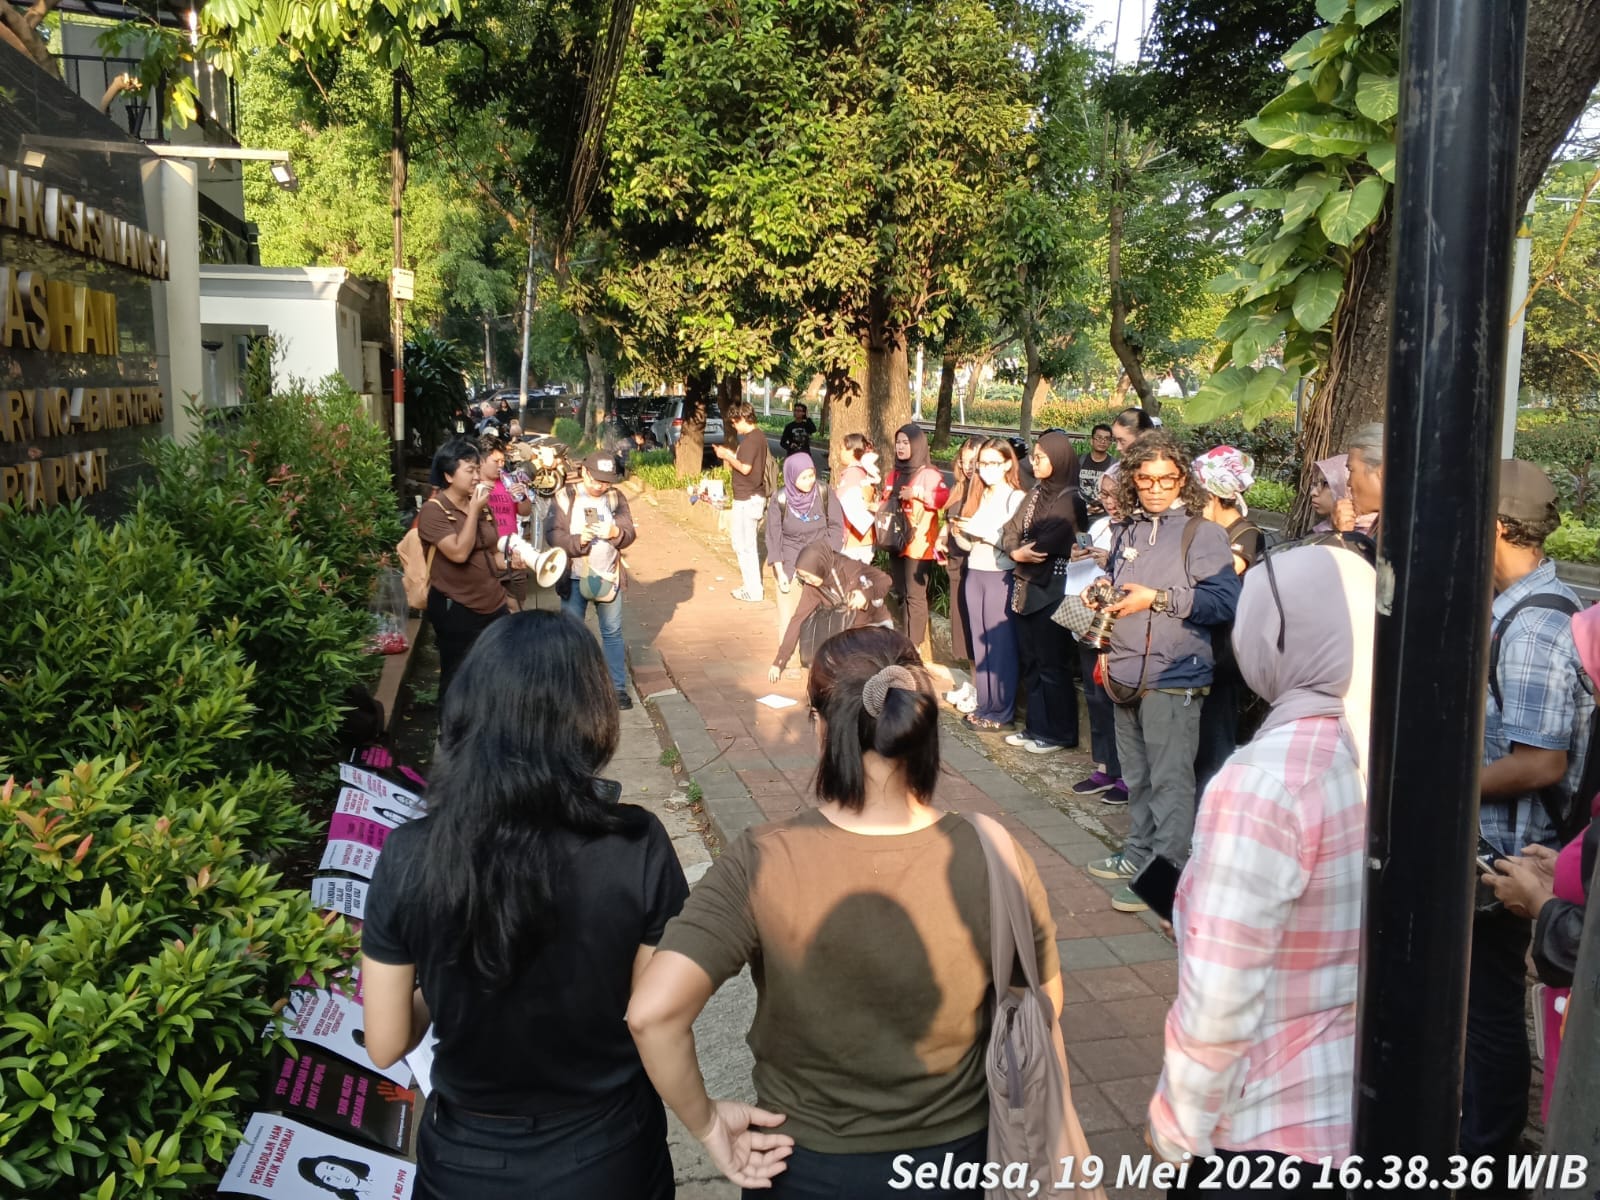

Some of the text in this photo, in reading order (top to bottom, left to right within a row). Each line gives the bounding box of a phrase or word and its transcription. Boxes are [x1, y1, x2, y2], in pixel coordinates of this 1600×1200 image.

[48, 280, 119, 356] HAM
[100, 386, 165, 430] MENTENG
[42, 448, 108, 504] PUSAT
[249, 1124, 284, 1184] PENGADILAN HAM
[262, 1128, 295, 1188] UNTUK MARSINAH
